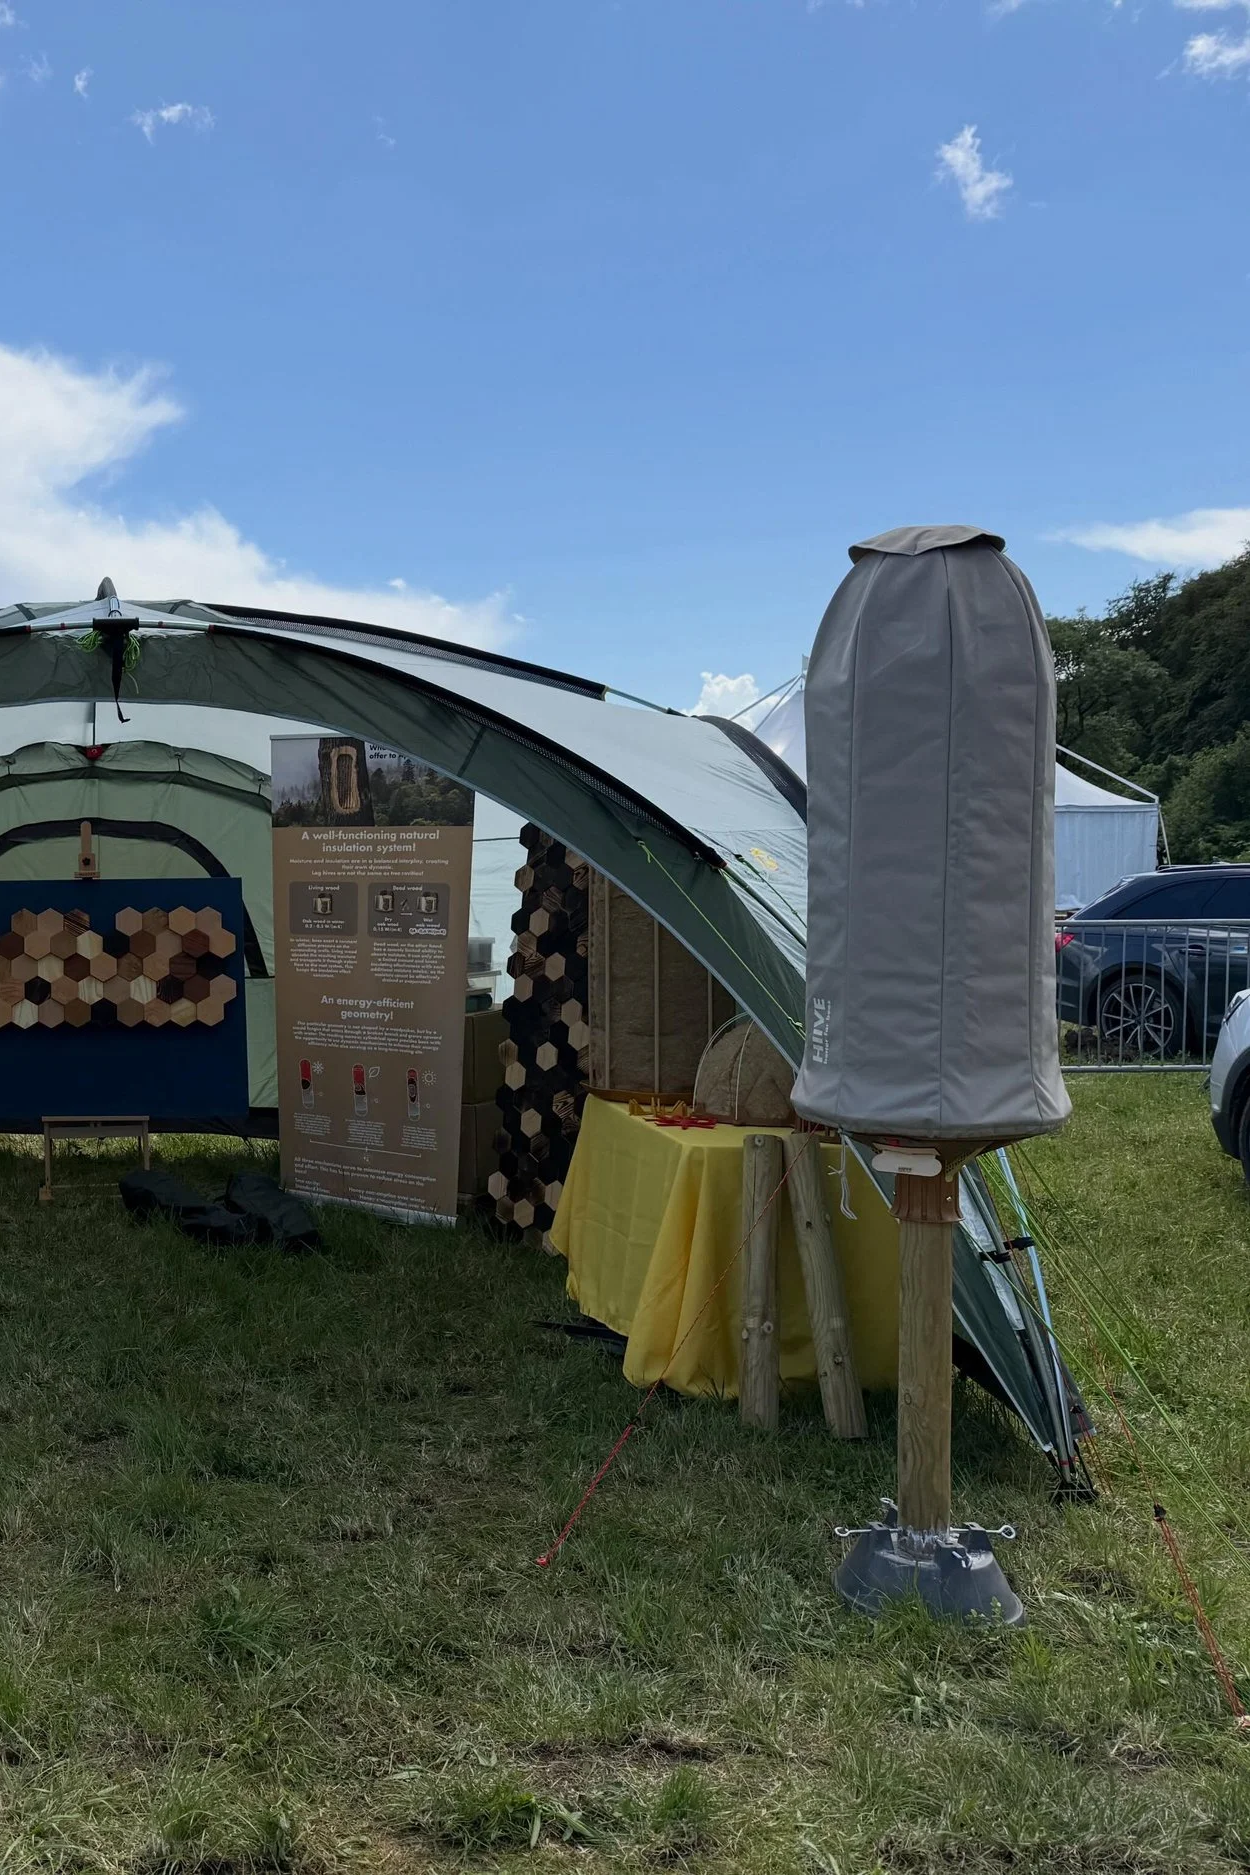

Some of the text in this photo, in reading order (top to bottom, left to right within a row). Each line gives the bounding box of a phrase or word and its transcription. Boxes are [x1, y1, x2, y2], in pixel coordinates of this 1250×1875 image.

[301, 829, 440, 842] A well-functioning natural
[322, 842, 416, 855] insulation system!
[321, 995, 414, 1010] An energy-efficient
[340, 1009, 394, 1022] geometry!
[812, 997, 826, 1063] HIIVE
